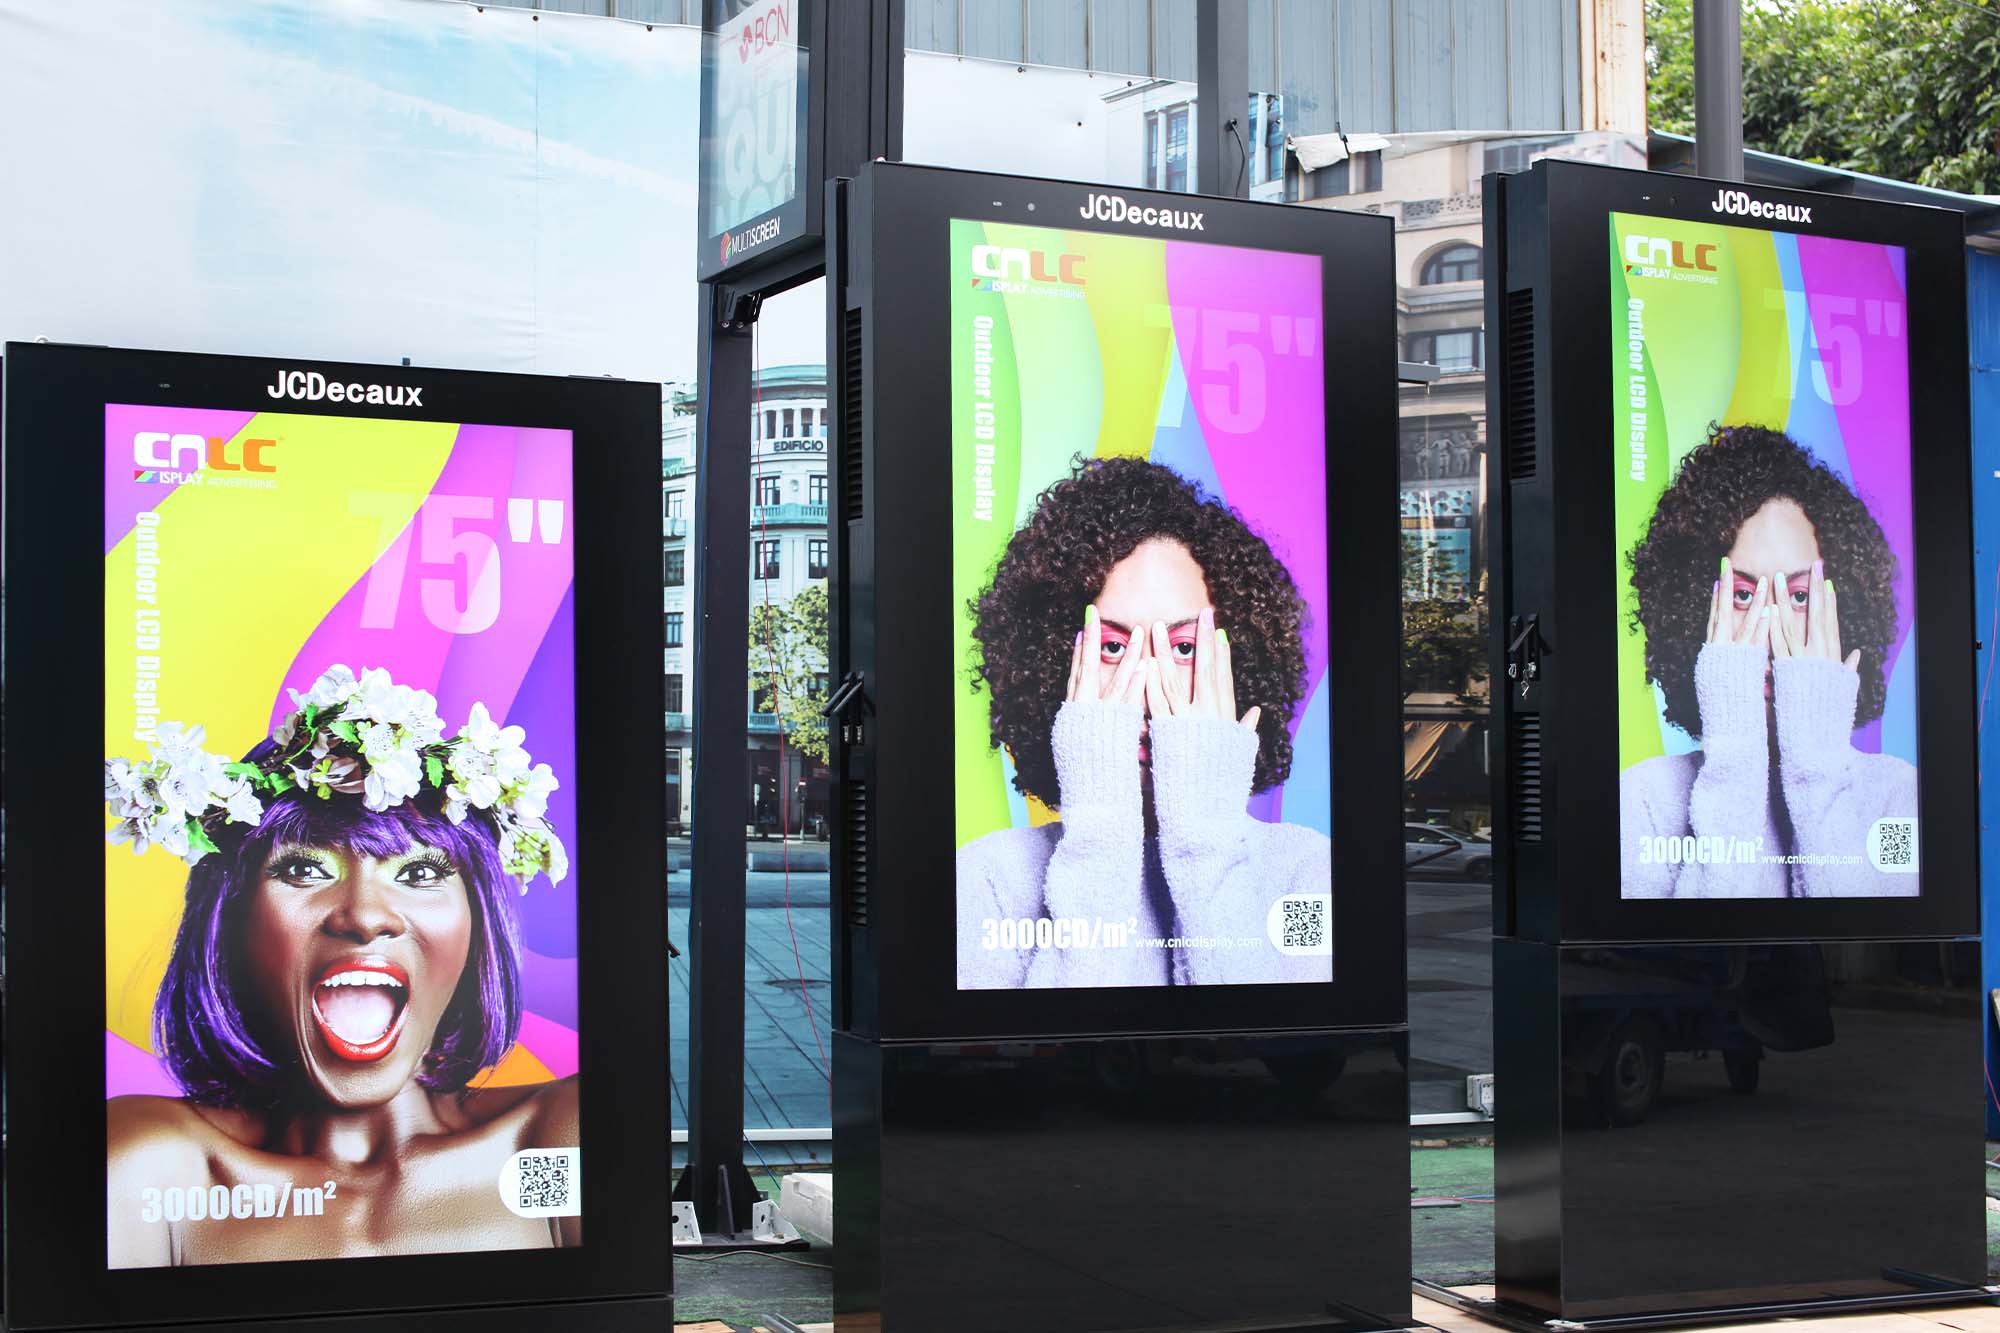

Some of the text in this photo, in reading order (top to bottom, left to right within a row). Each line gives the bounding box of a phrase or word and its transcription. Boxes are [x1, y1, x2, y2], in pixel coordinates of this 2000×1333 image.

[754, 0, 790, 54] BCN
[1080, 193, 1205, 231] JCDecaux
[1711, 189, 1812, 224] JCDecaux
[731, 216, 780, 256] MULTISCREEN
[267, 370, 424, 407] JCDecaux
[1628, 297, 1648, 482] Outdoor LCD Display
[974, 315, 996, 522] Outdoor LCD Display
[773, 440, 824, 452] EDIFICIO
[133, 511, 161, 742] Outdoor LCD Display
